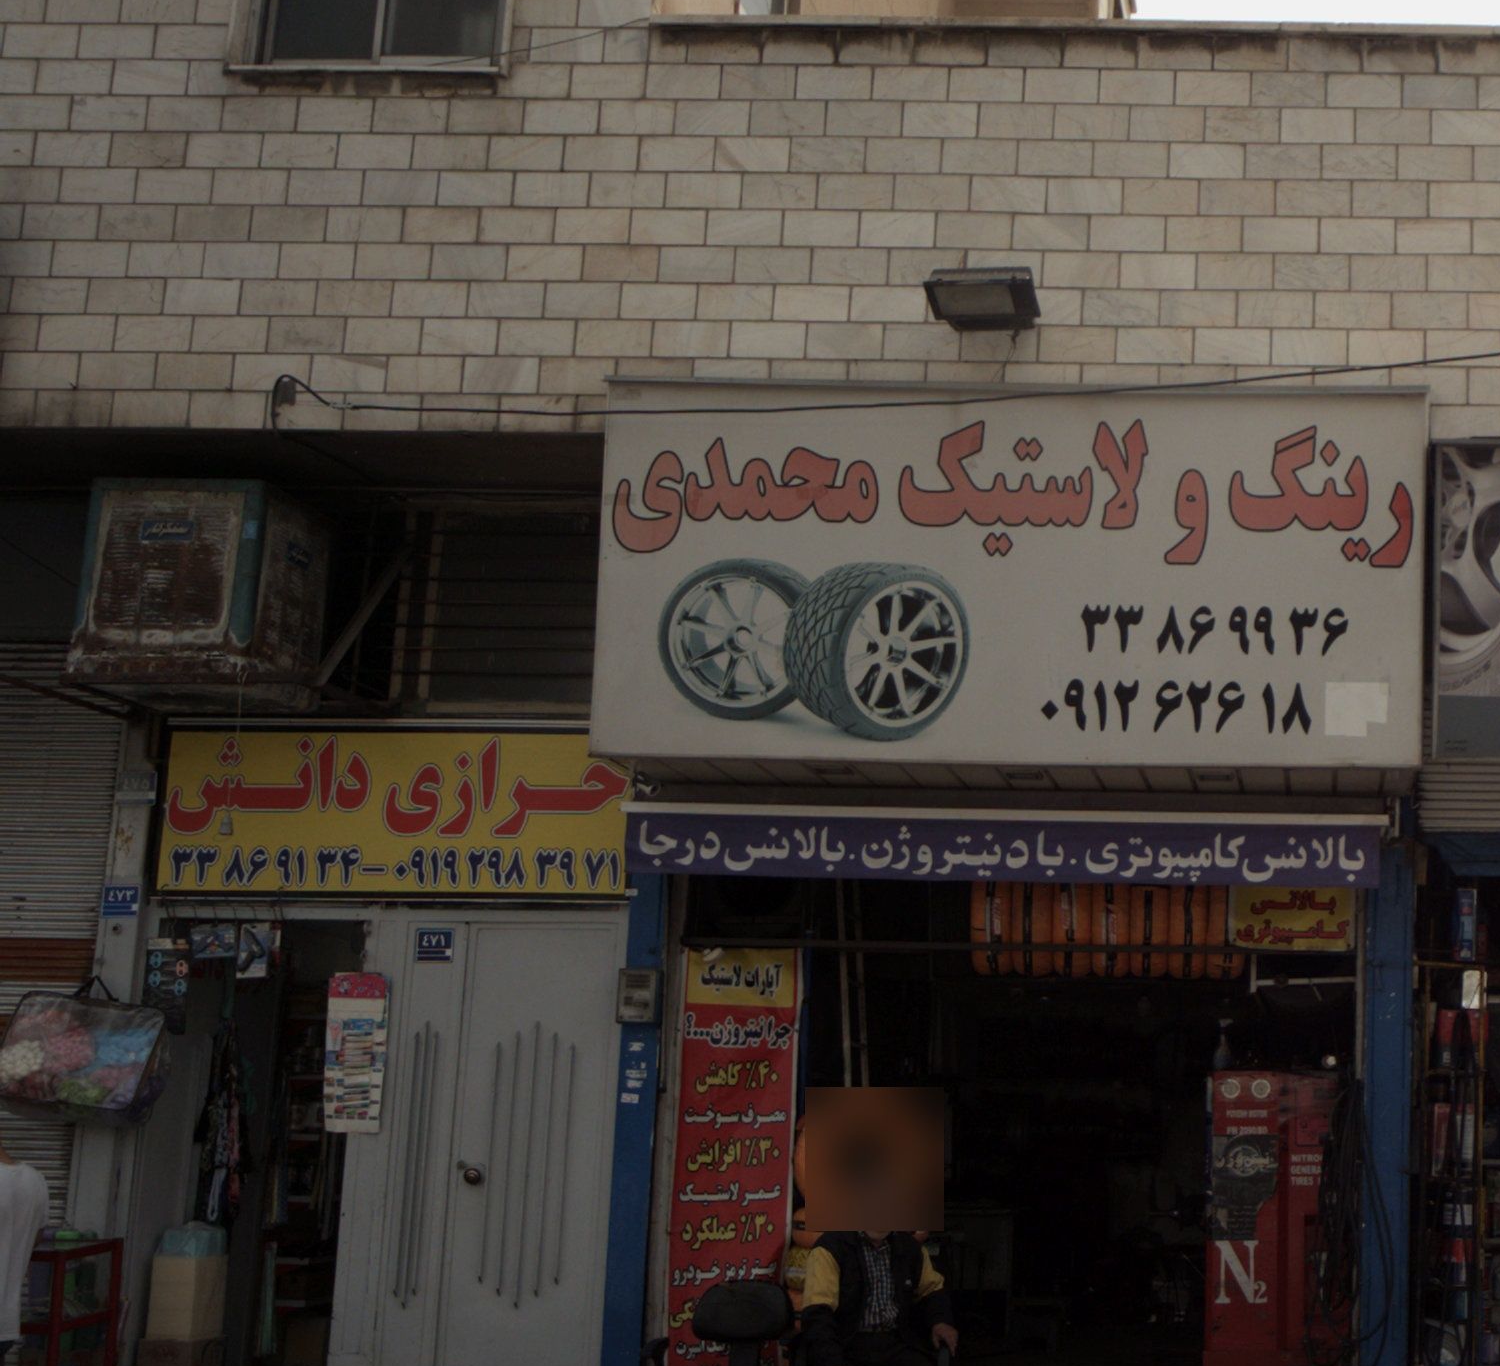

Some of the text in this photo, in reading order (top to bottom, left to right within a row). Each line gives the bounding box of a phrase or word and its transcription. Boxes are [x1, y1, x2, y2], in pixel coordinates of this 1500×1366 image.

[612, 419, 1414, 568] رینگ و لاستیک محمدی
[166, 736, 371, 835] دانش
[723, 825, 846, 872] بالانس
[1085, 831, 1247, 883] کامپیوتری
[1242, 834, 1366, 883] بالانس
[1250, 890, 1337, 917] بالانس
[1236, 918, 1350, 946] کامپیوتری
[700, 964, 743, 992] لاستیک
[695, 1060, 743, 1094] کاهش
[683, 1102, 788, 1130] مصرف سوخت
[678, 1181, 740, 1206] لاستیک
